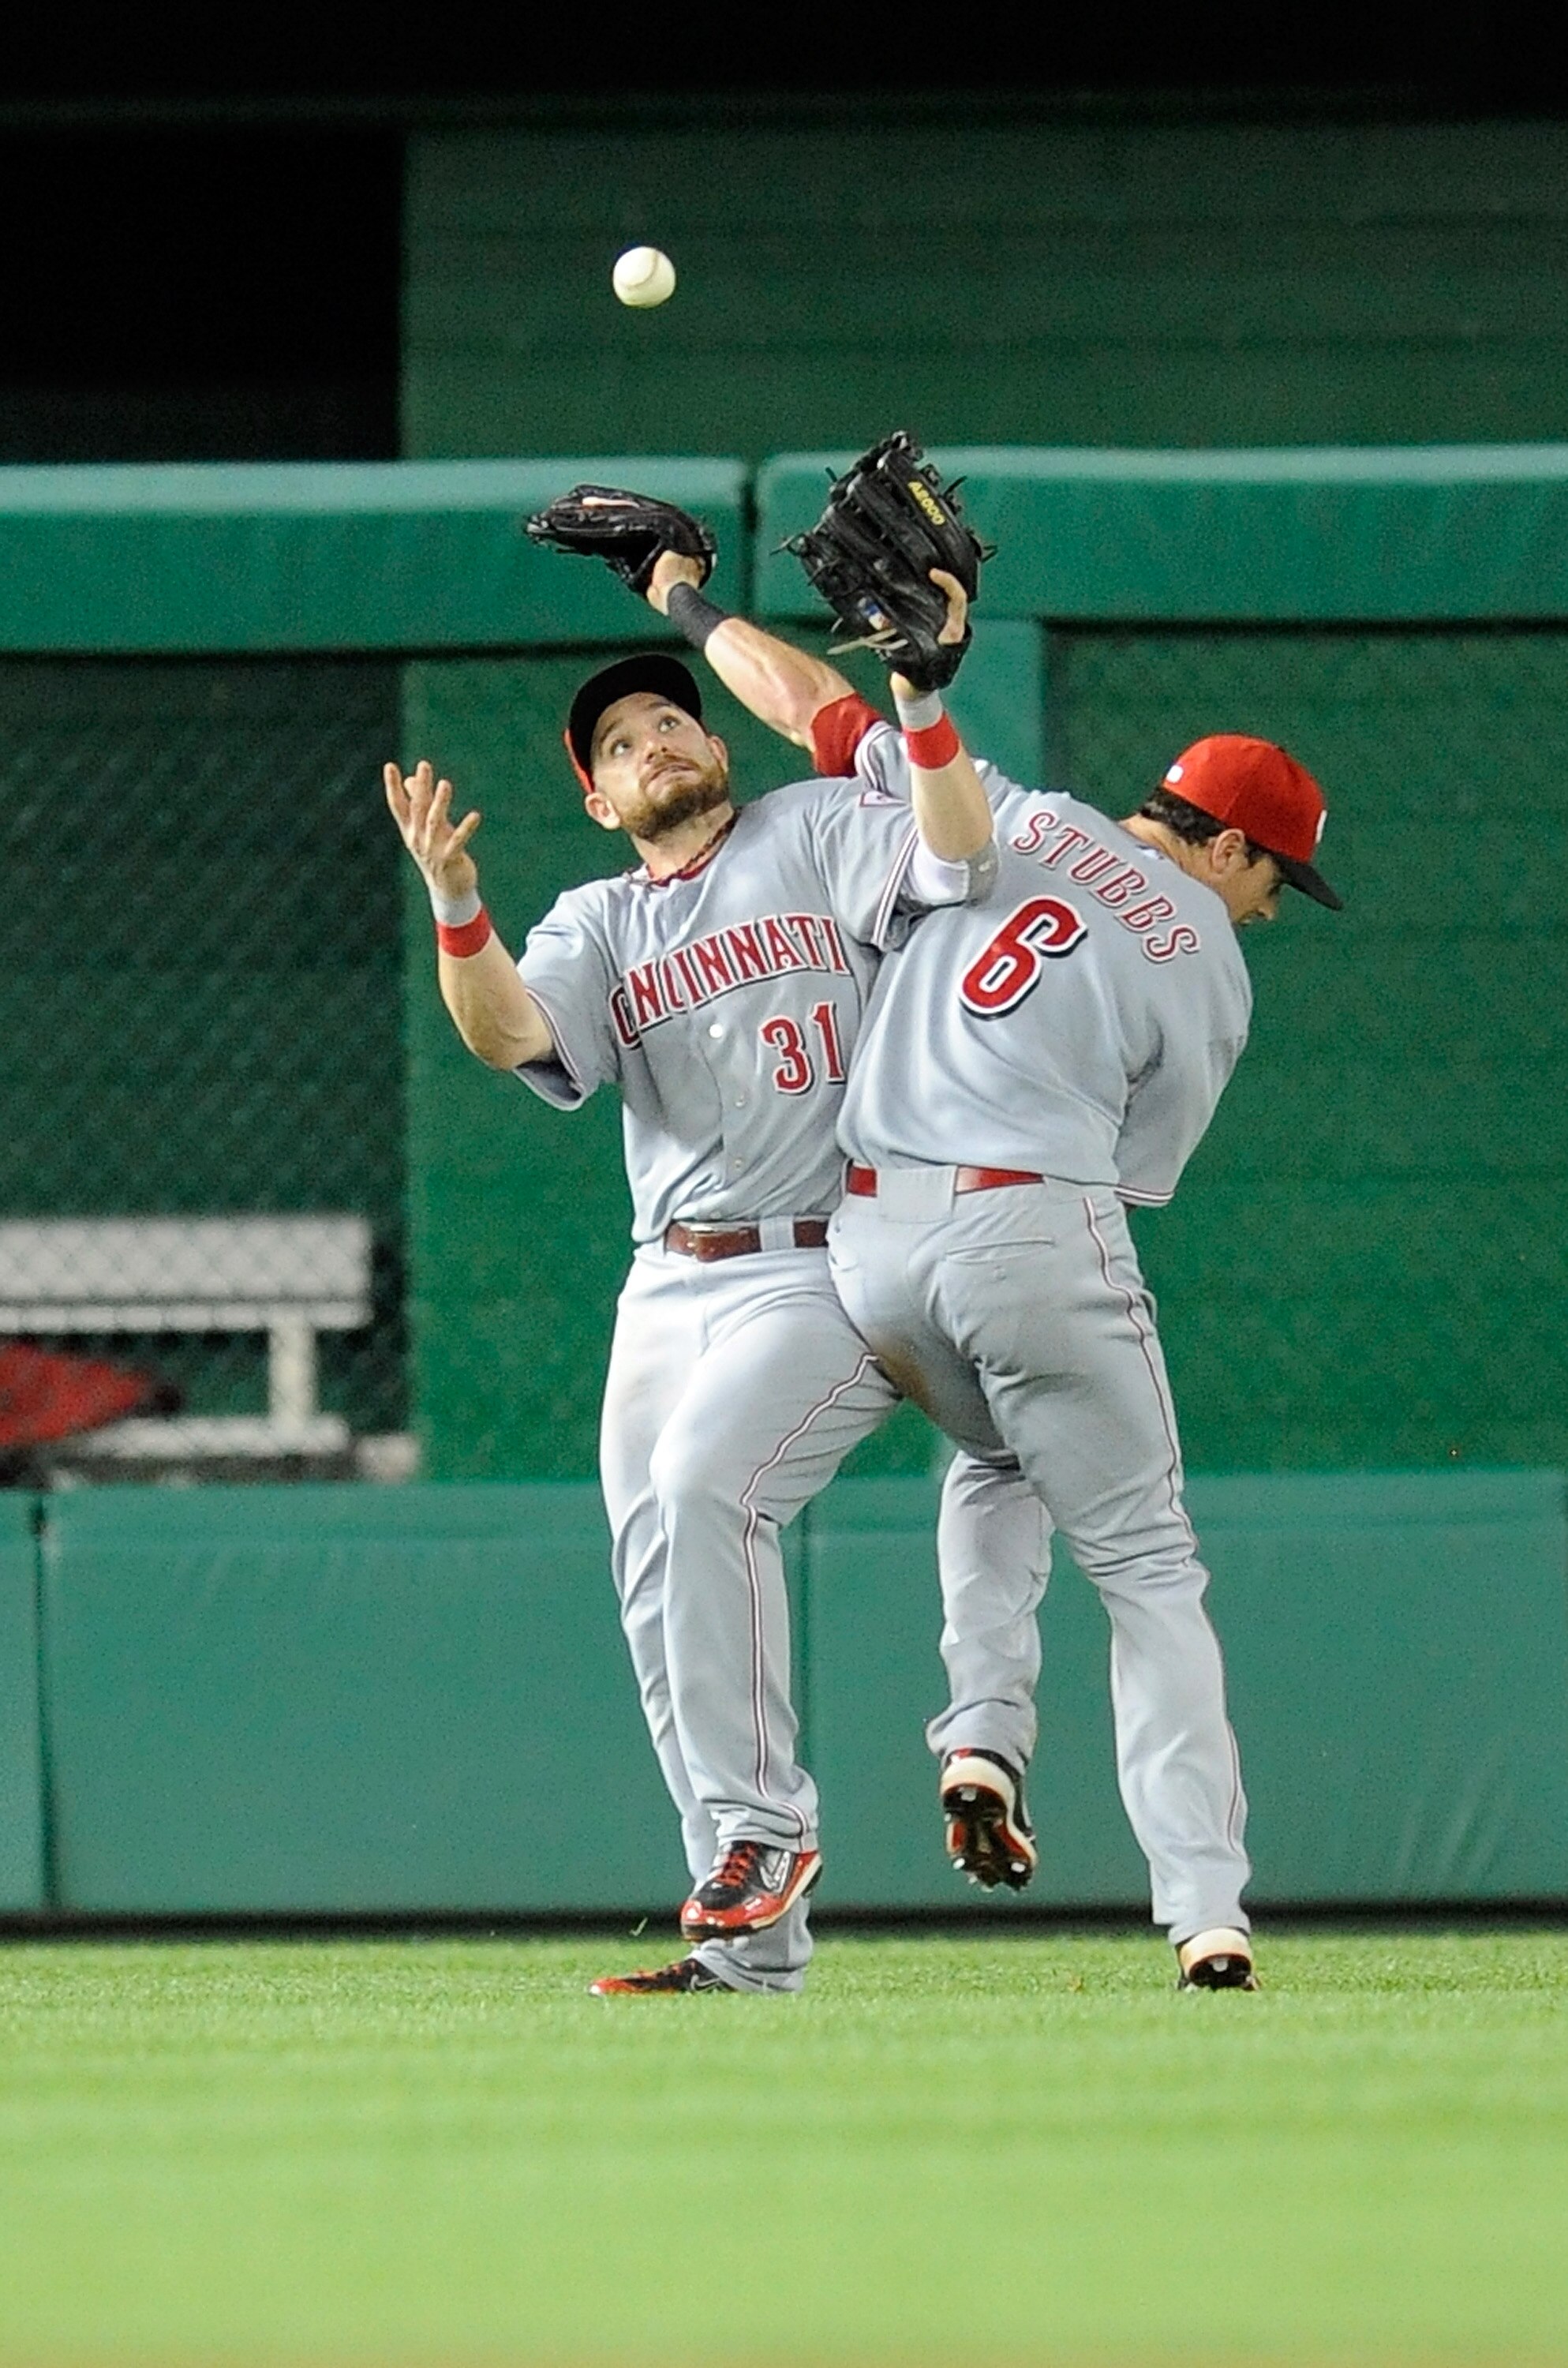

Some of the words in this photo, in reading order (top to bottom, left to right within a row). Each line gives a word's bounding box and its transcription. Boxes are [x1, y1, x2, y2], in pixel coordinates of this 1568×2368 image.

[1009, 808, 1201, 965] STUBBS
[958, 894, 1088, 1021] 6
[759, 1000, 847, 1096] 31
